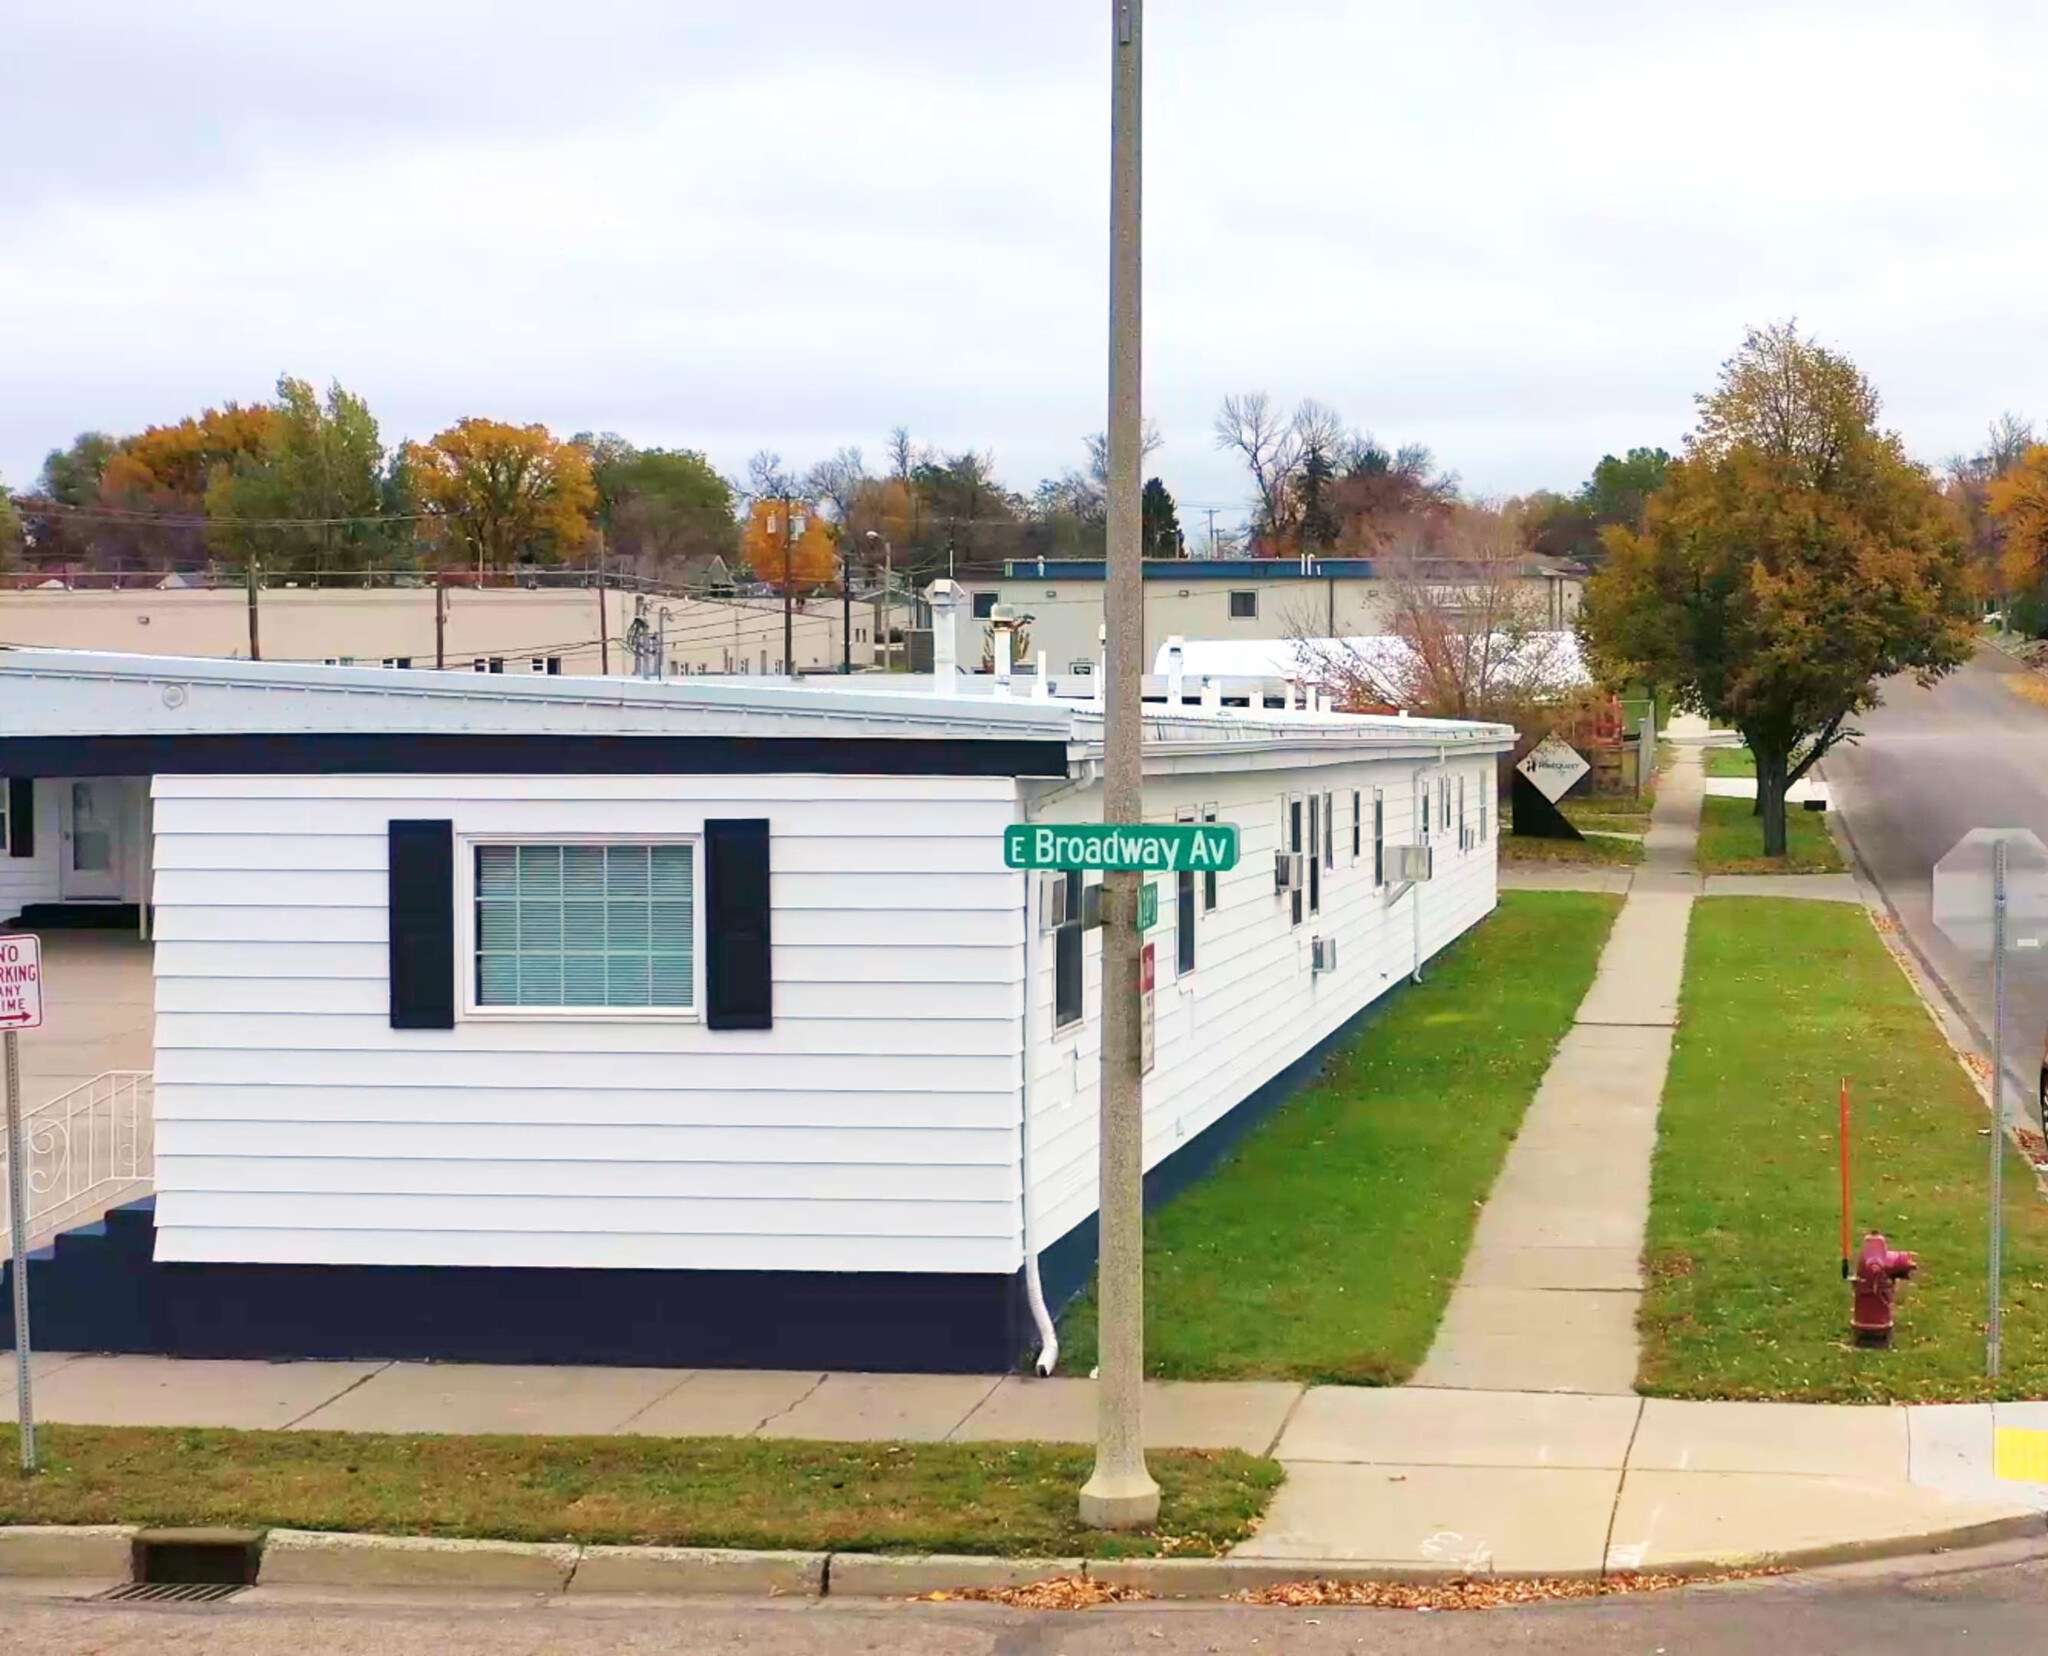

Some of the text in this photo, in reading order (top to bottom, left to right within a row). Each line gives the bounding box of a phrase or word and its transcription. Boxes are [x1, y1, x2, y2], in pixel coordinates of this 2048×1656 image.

[1012, 829, 1227, 871] E Broadway Av
